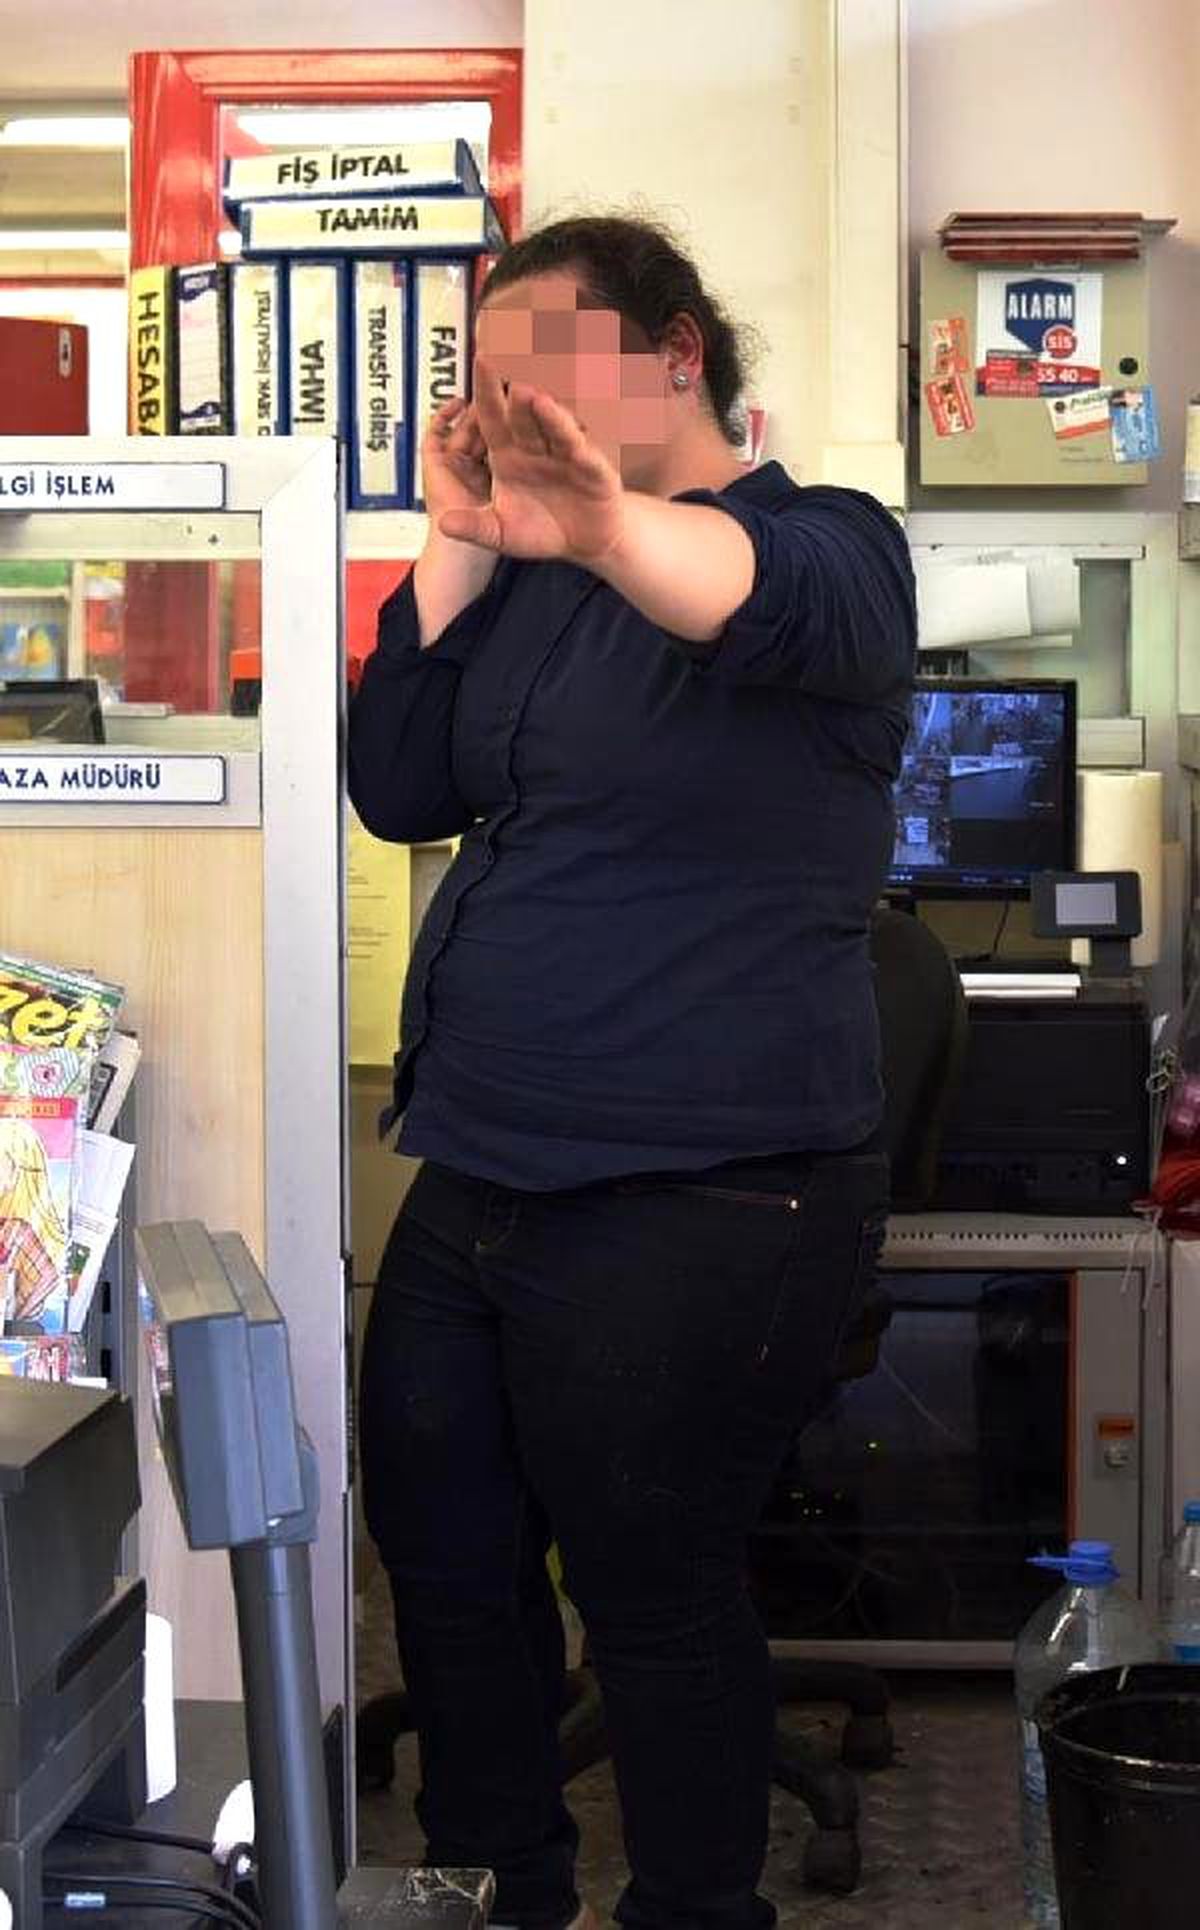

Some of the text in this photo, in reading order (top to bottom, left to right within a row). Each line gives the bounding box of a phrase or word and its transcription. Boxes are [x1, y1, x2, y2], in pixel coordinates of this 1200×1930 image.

[277, 153, 409, 188] FİŞ İPTAL
[316, 205, 419, 232] TAMİM
[1007, 292, 1073, 320] ALARM
[293, 340, 325, 423] İMHA
[366, 306, 393, 452] TRANSİT GİRİŞ
[430, 326, 456, 410] FATU
[46, 470, 115, 501] İŞLEM
[61, 763, 161, 789] MÜDÜRÜ
